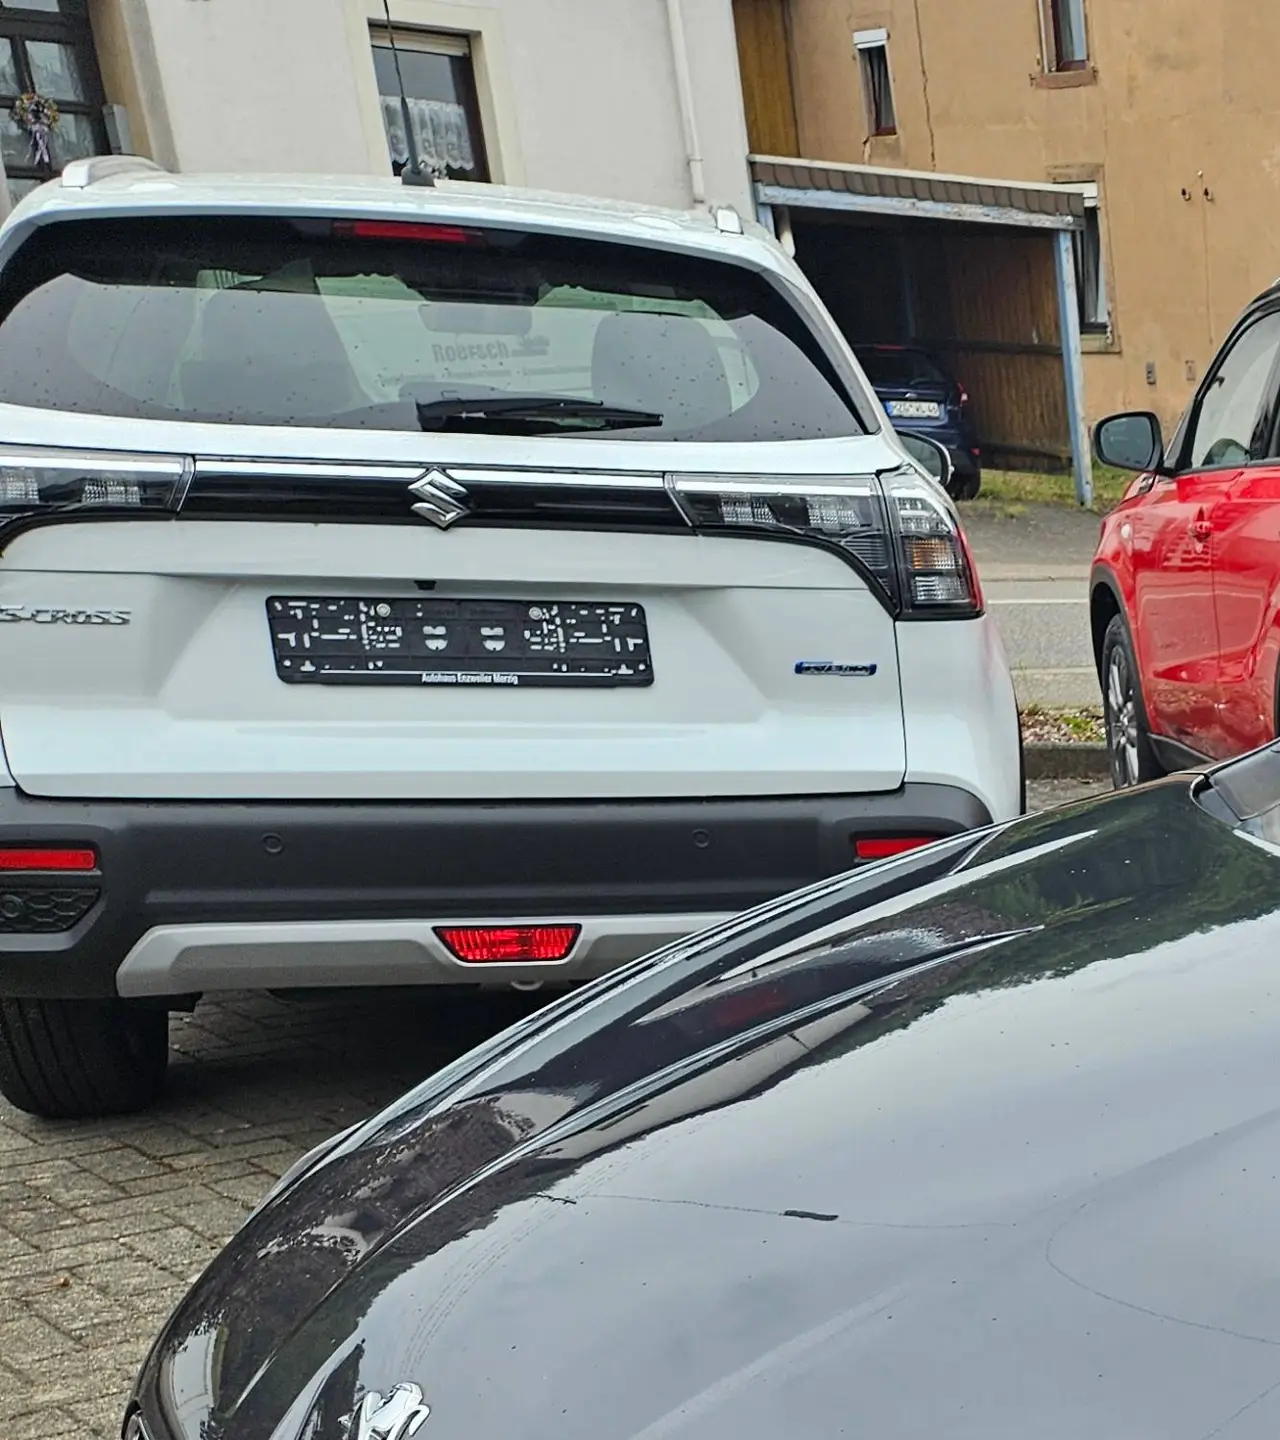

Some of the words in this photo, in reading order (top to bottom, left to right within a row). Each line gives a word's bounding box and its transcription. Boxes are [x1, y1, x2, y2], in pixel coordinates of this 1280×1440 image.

[0, 605, 131, 625] S-CROSS
[421, 672, 457, 683] Autohaus
[493, 673, 519, 685] Merzig
